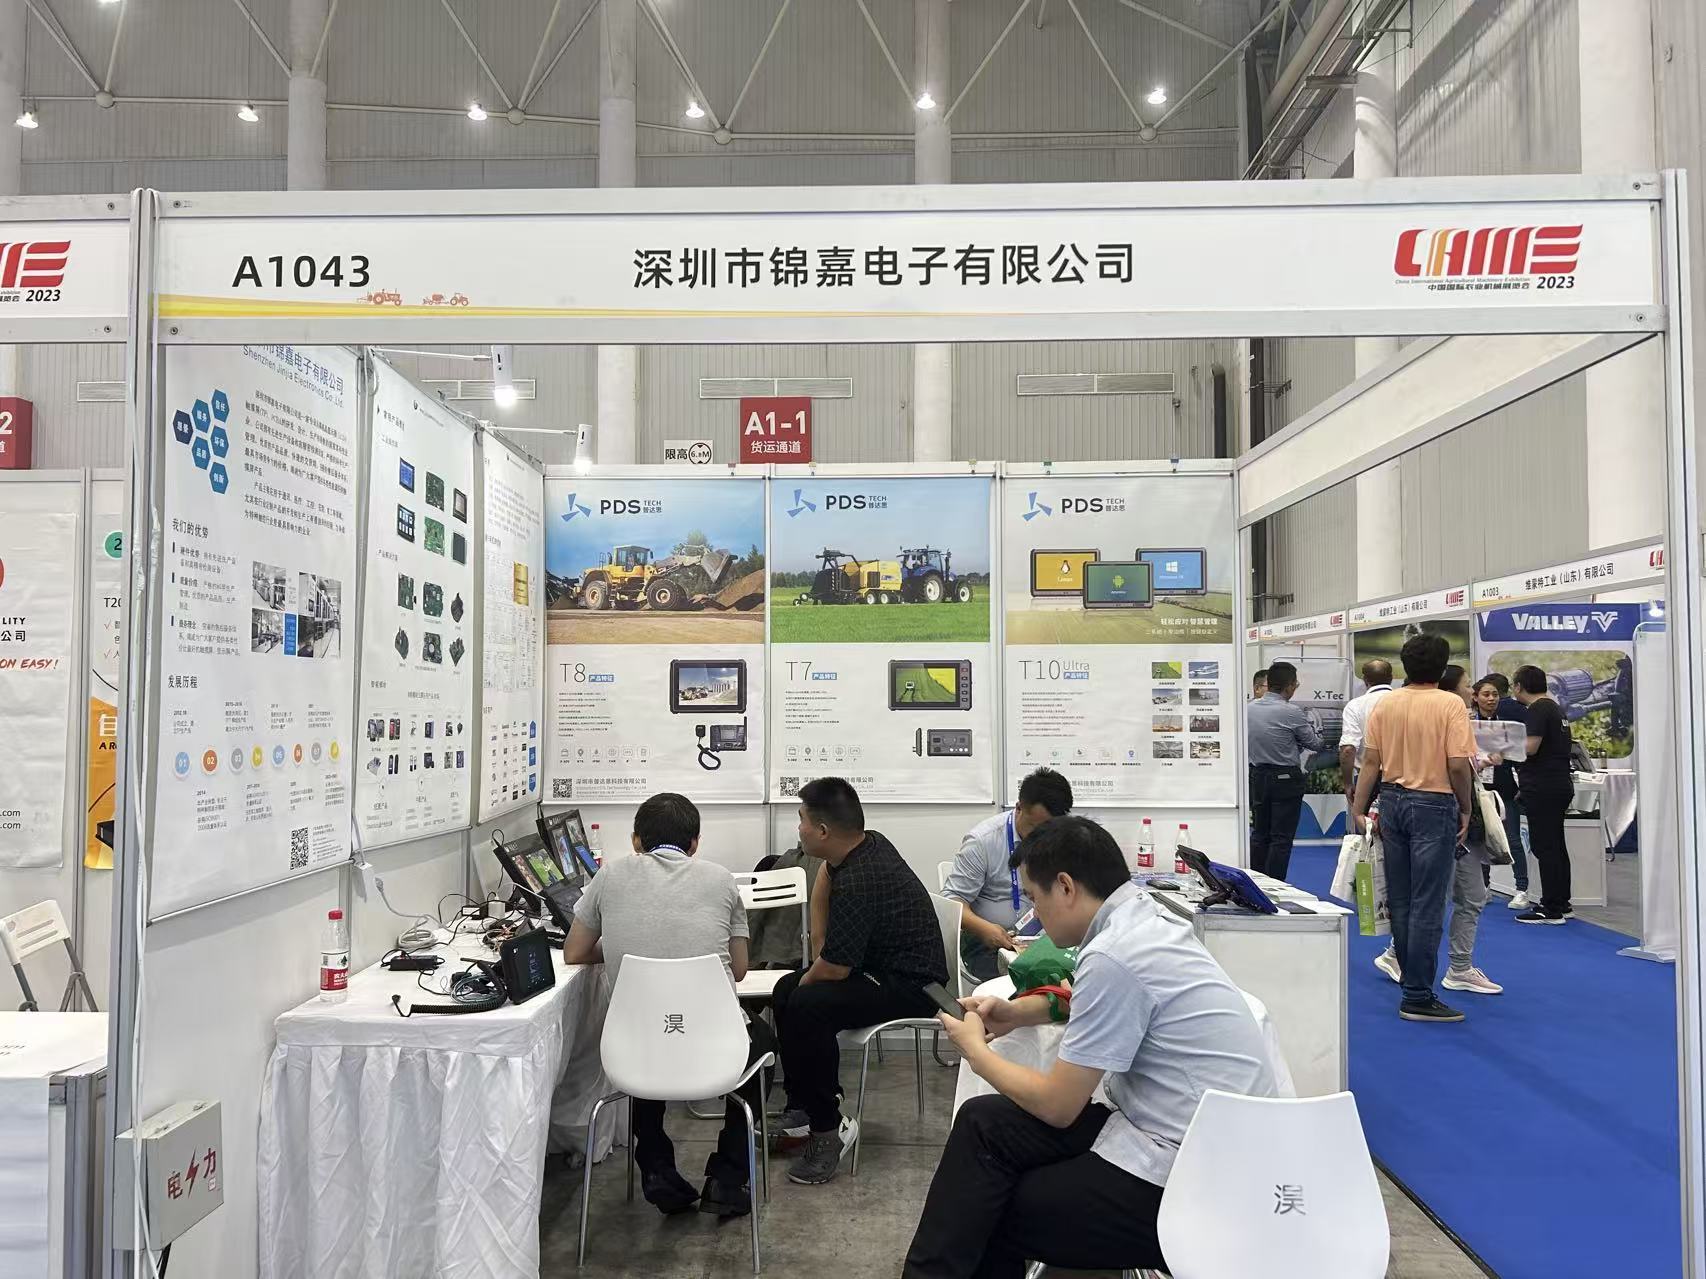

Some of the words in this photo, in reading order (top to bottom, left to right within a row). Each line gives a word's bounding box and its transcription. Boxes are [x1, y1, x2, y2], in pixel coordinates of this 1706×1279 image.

[231, 255, 370, 288] A1043
[633, 243, 1134, 289] 深圳市锦嘉电子有限公司
[1536, 276, 1575, 290] 2023
[26, 290, 61, 302] 2023
[744, 411, 806, 435] A1-1
[665, 449, 688, 460] 限高
[751, 441, 801, 454] 货运通道
[600, 499, 641, 514] PDS
[826, 495, 866, 510] PDS
[1062, 498, 1103, 513] PDS
[172, 518, 209, 539] 我们的优势
[1482, 586, 1499, 598] A1003
[3, 617, 26, 625] LITY
[1511, 613, 1589, 634] VALLEY
[1, 630, 26, 642] 公司
[21, 658, 58, 670] EASY!
[785, 661, 812, 680] T7
[1018, 660, 1060, 680] T10
[1063, 660, 1090, 670] Ultra
[560, 663, 586, 683] T8
[1064, 672, 1088, 680] 产品特征
[168, 674, 198, 689] 发展历程
[1314, 690, 1344, 700] X-Tec
[168, 1170, 183, 1200] 电
[203, 1147, 216, 1179] 力
